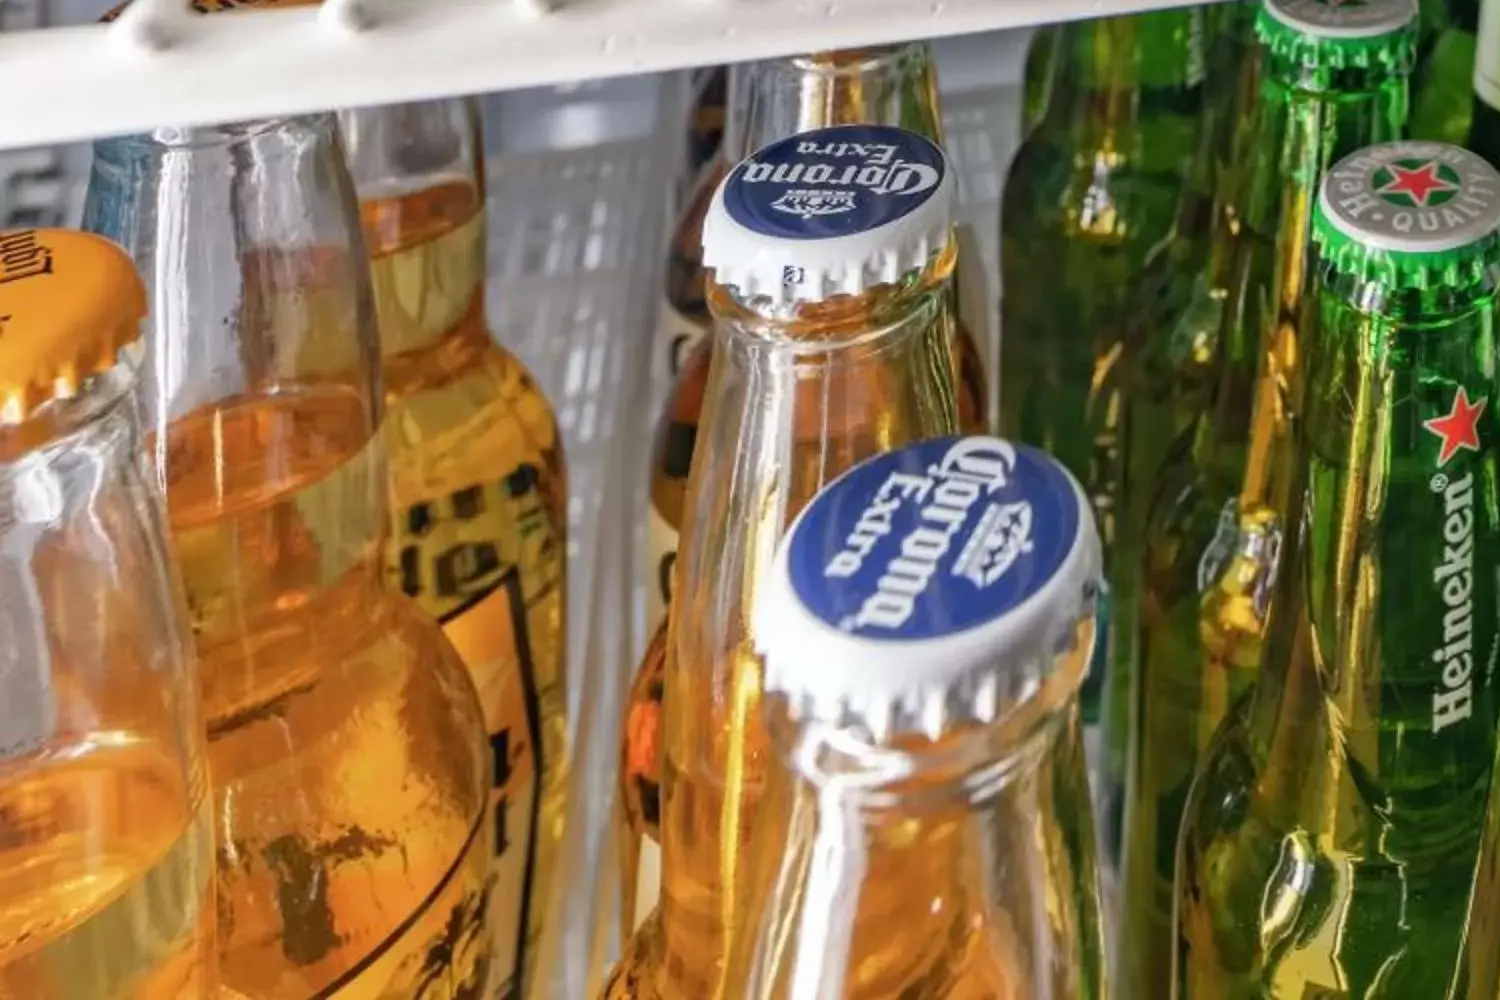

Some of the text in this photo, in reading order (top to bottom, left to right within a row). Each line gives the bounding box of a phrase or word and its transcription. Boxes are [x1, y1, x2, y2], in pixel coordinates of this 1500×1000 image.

[742, 158, 939, 197] Corona
[796, 140, 899, 166] Extra
[1391, 172, 1496, 233] QUALITY
[823, 471, 935, 578] Extra
[838, 434, 1018, 629] Corona
[1431, 470, 1474, 735] Heineken
